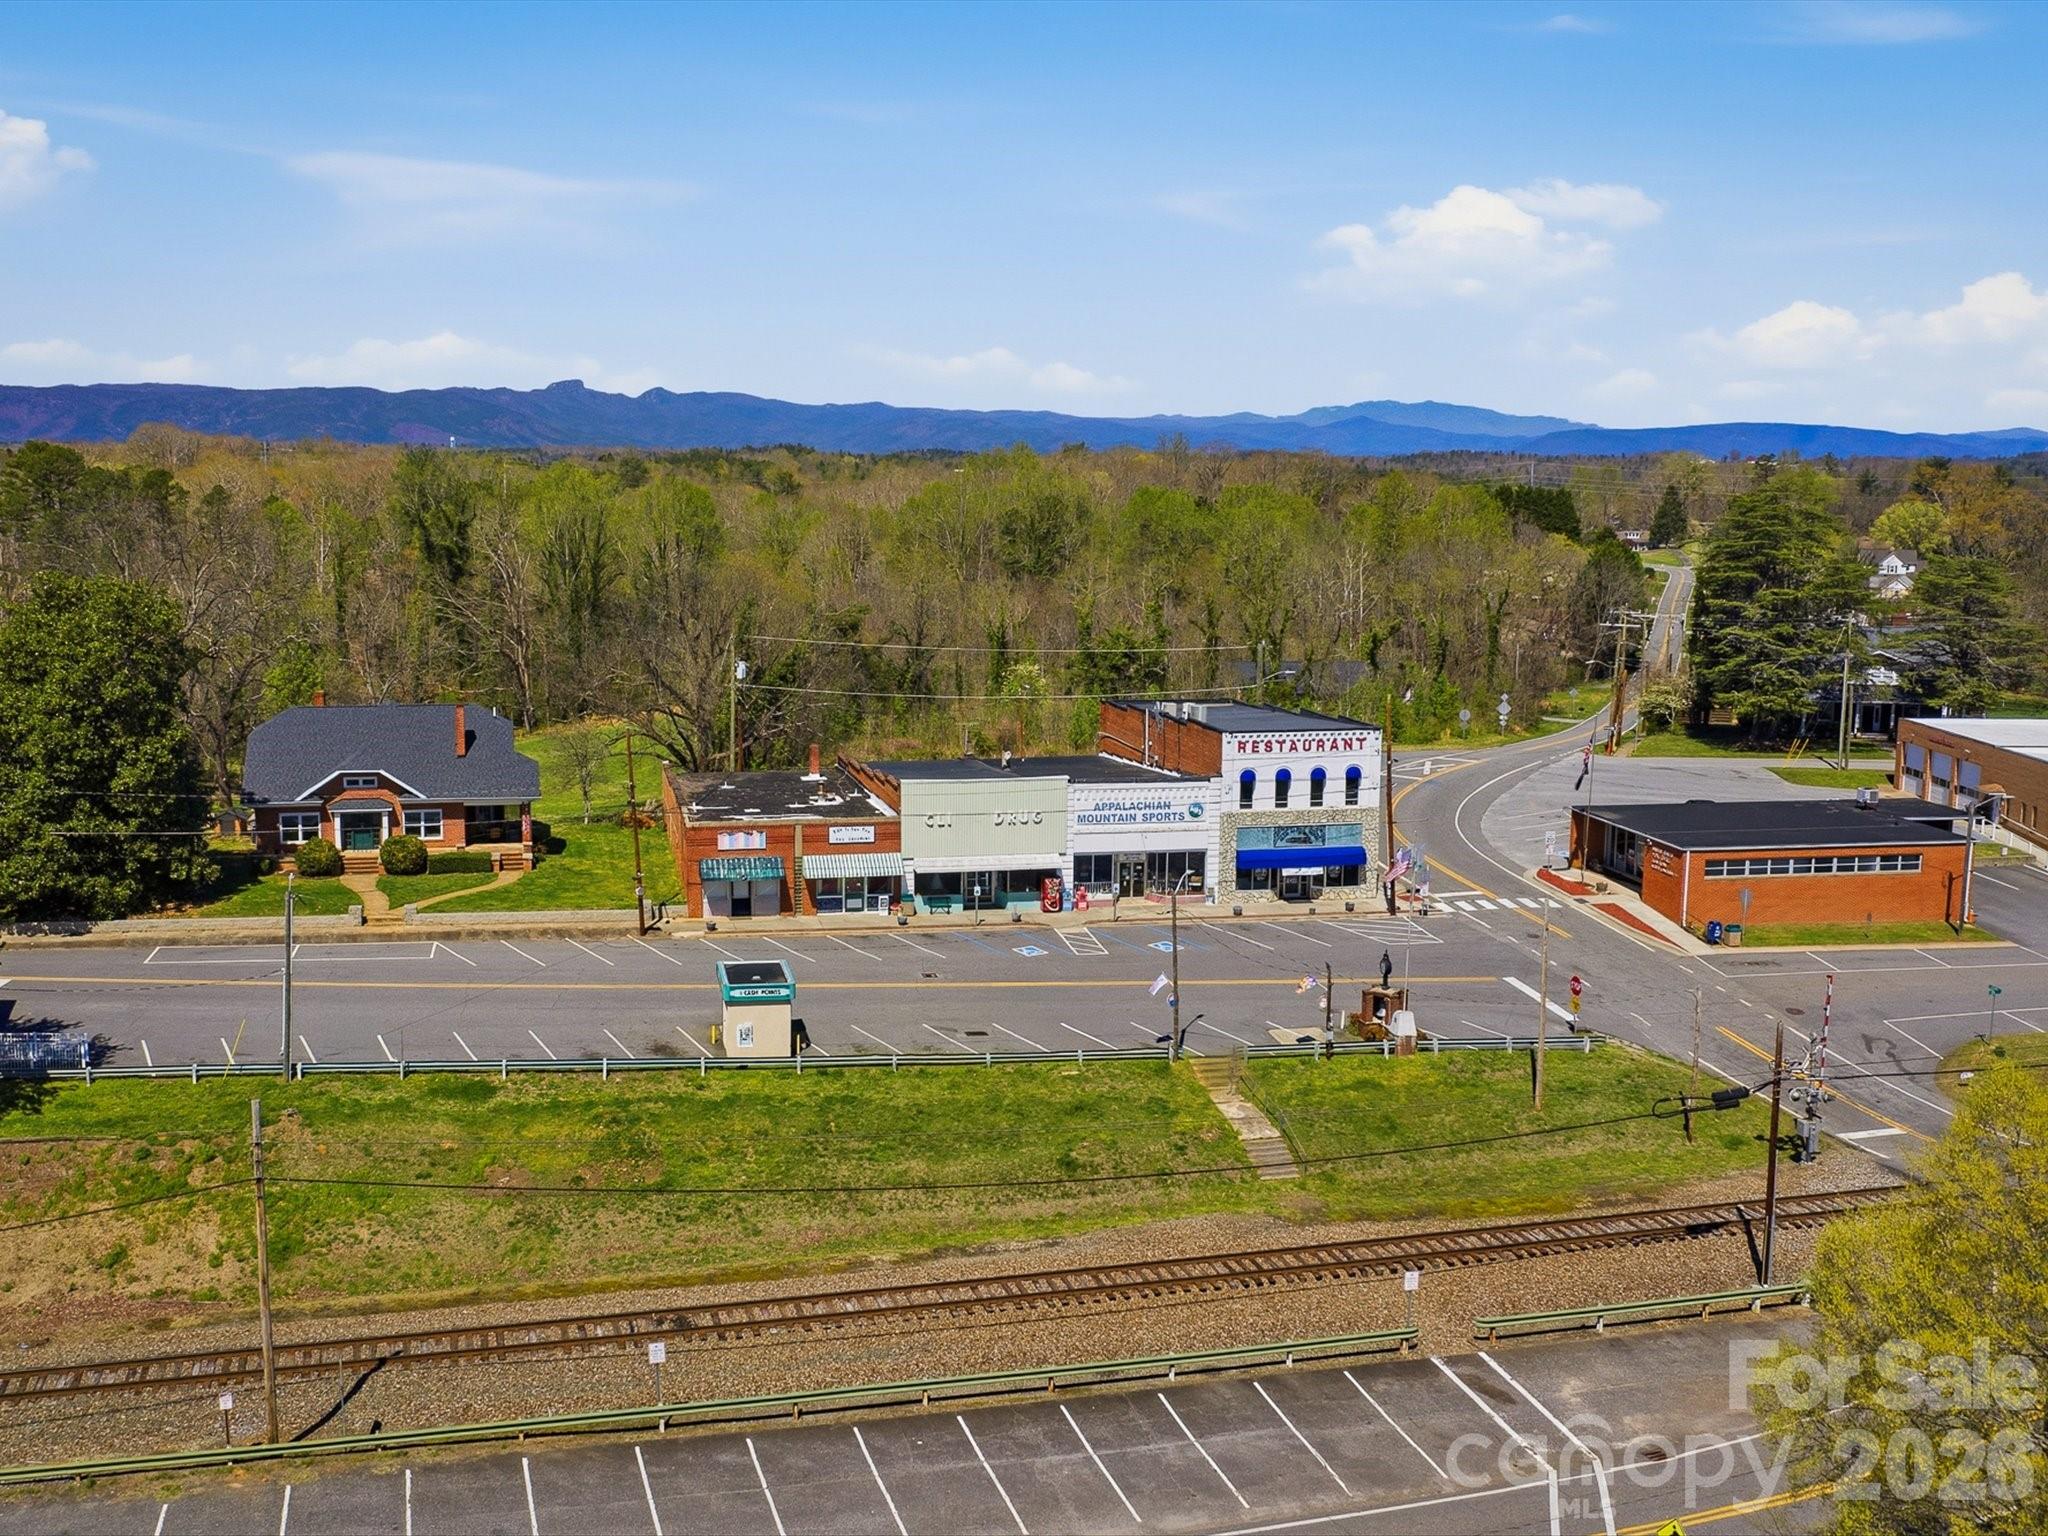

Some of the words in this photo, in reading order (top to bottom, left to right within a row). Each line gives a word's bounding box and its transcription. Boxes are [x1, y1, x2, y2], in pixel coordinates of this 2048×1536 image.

[1237, 737, 1367, 753] RESTAURANT
[1093, 801, 1171, 812] APPALACHIAN
[993, 809, 1043, 826] DRUG
[1077, 813, 1137, 823] MOUNTAIN
[1141, 812, 1185, 822] SPORTS
